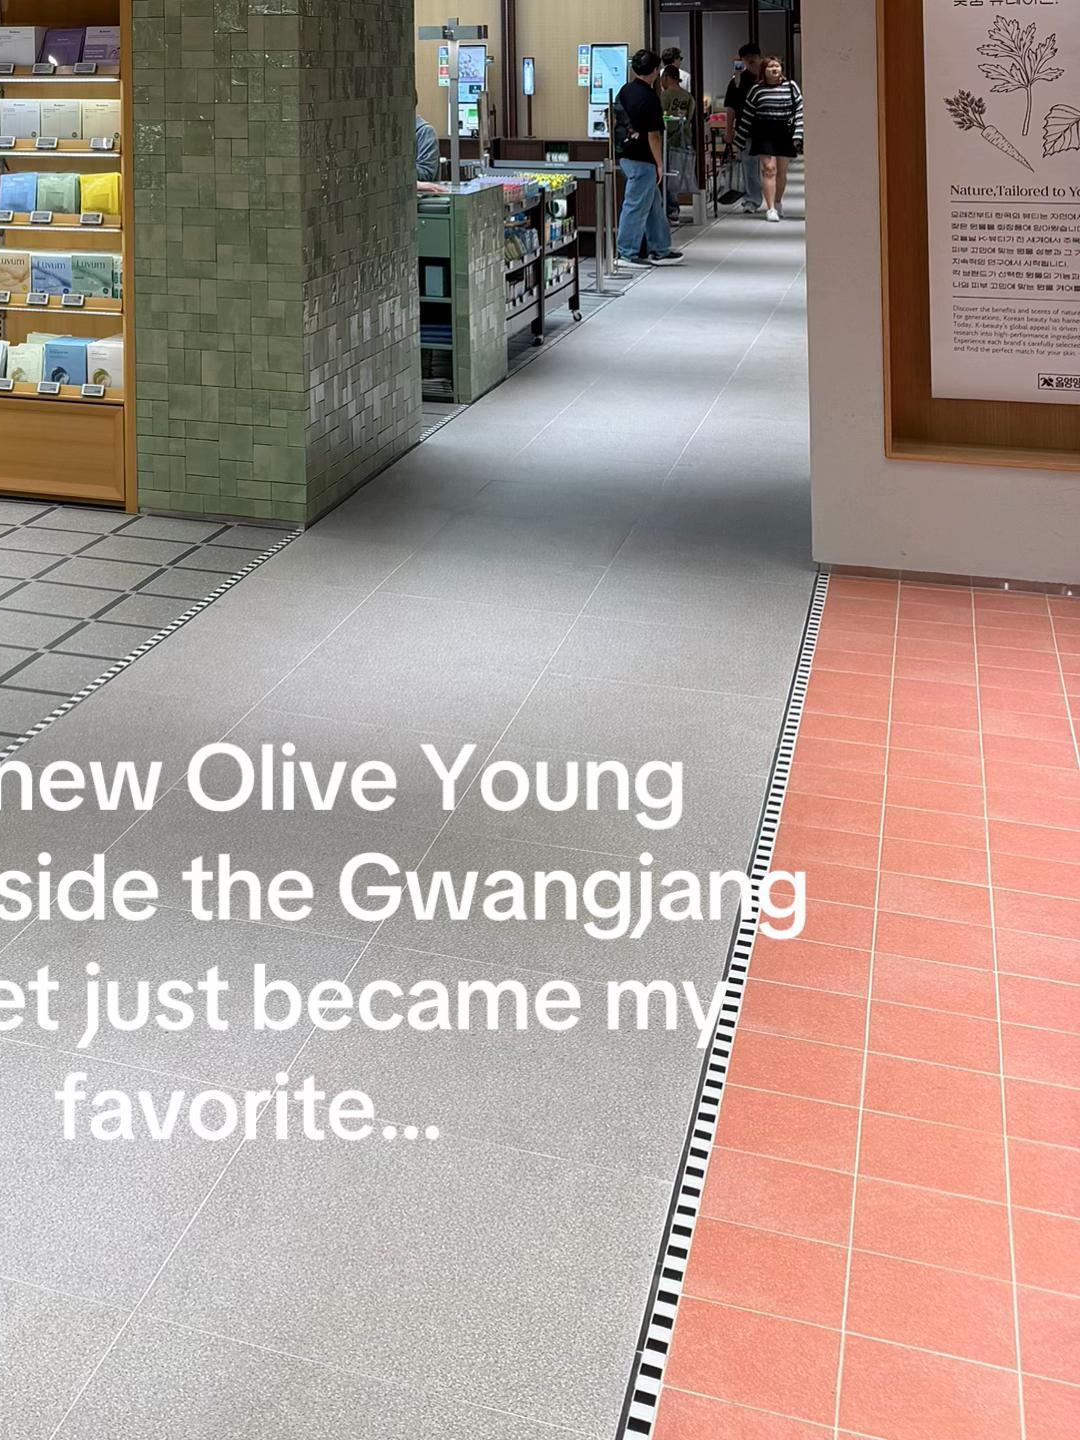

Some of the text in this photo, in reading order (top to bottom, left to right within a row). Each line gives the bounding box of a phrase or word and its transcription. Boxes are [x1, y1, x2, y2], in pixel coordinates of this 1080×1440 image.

[1052, 187, 1066, 197] to
[37, 260, 66, 269] Luvum
[76, 259, 106, 269] Luvum
